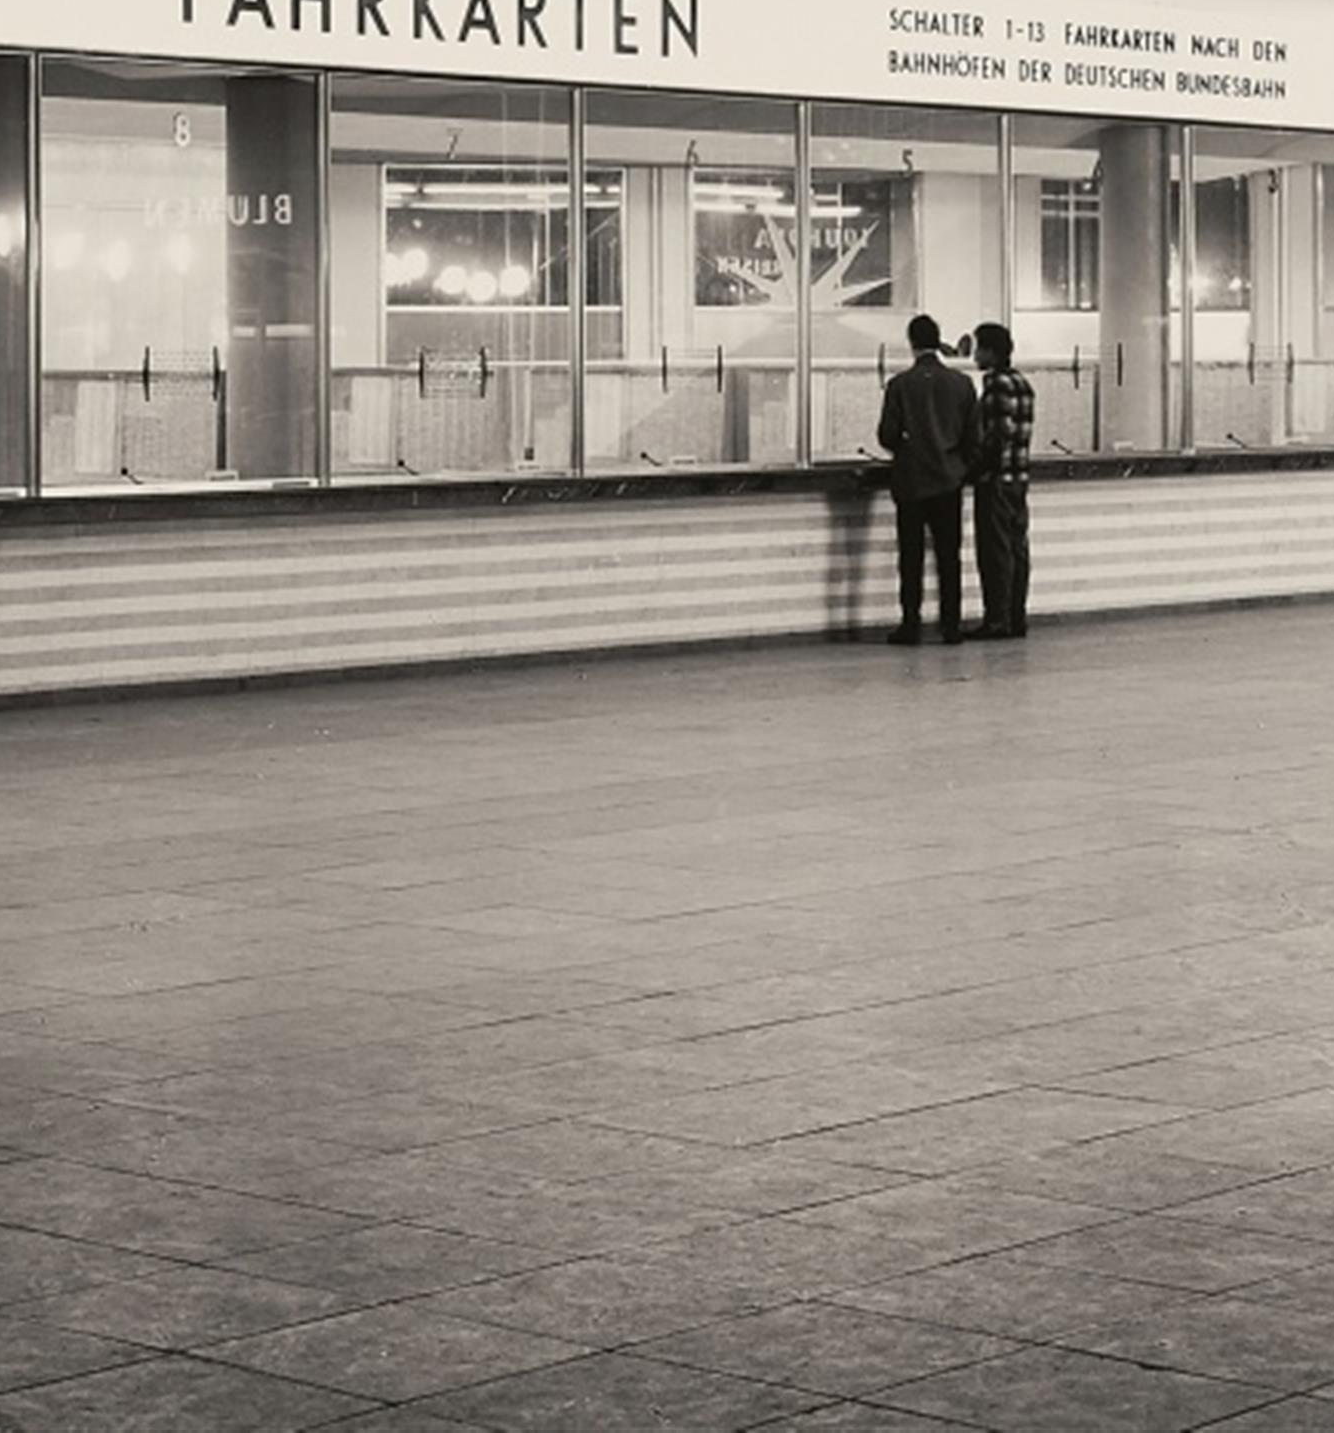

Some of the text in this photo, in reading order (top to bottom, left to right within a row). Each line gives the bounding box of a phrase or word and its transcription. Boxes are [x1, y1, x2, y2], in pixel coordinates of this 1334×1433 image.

[889, 8, 984, 37] SCHALTER
[1064, 22, 1176, 53] FAHRKARTEN
[1191, 34, 1239, 58] NACH
[1253, 40, 1286, 62] DEN
[888, 49, 1286, 98] BAHNHÖFEN DER DEUTSCHEN BUNDESBAHN
[173, 112, 191, 148] 8
[901, 149, 914, 177] 5
